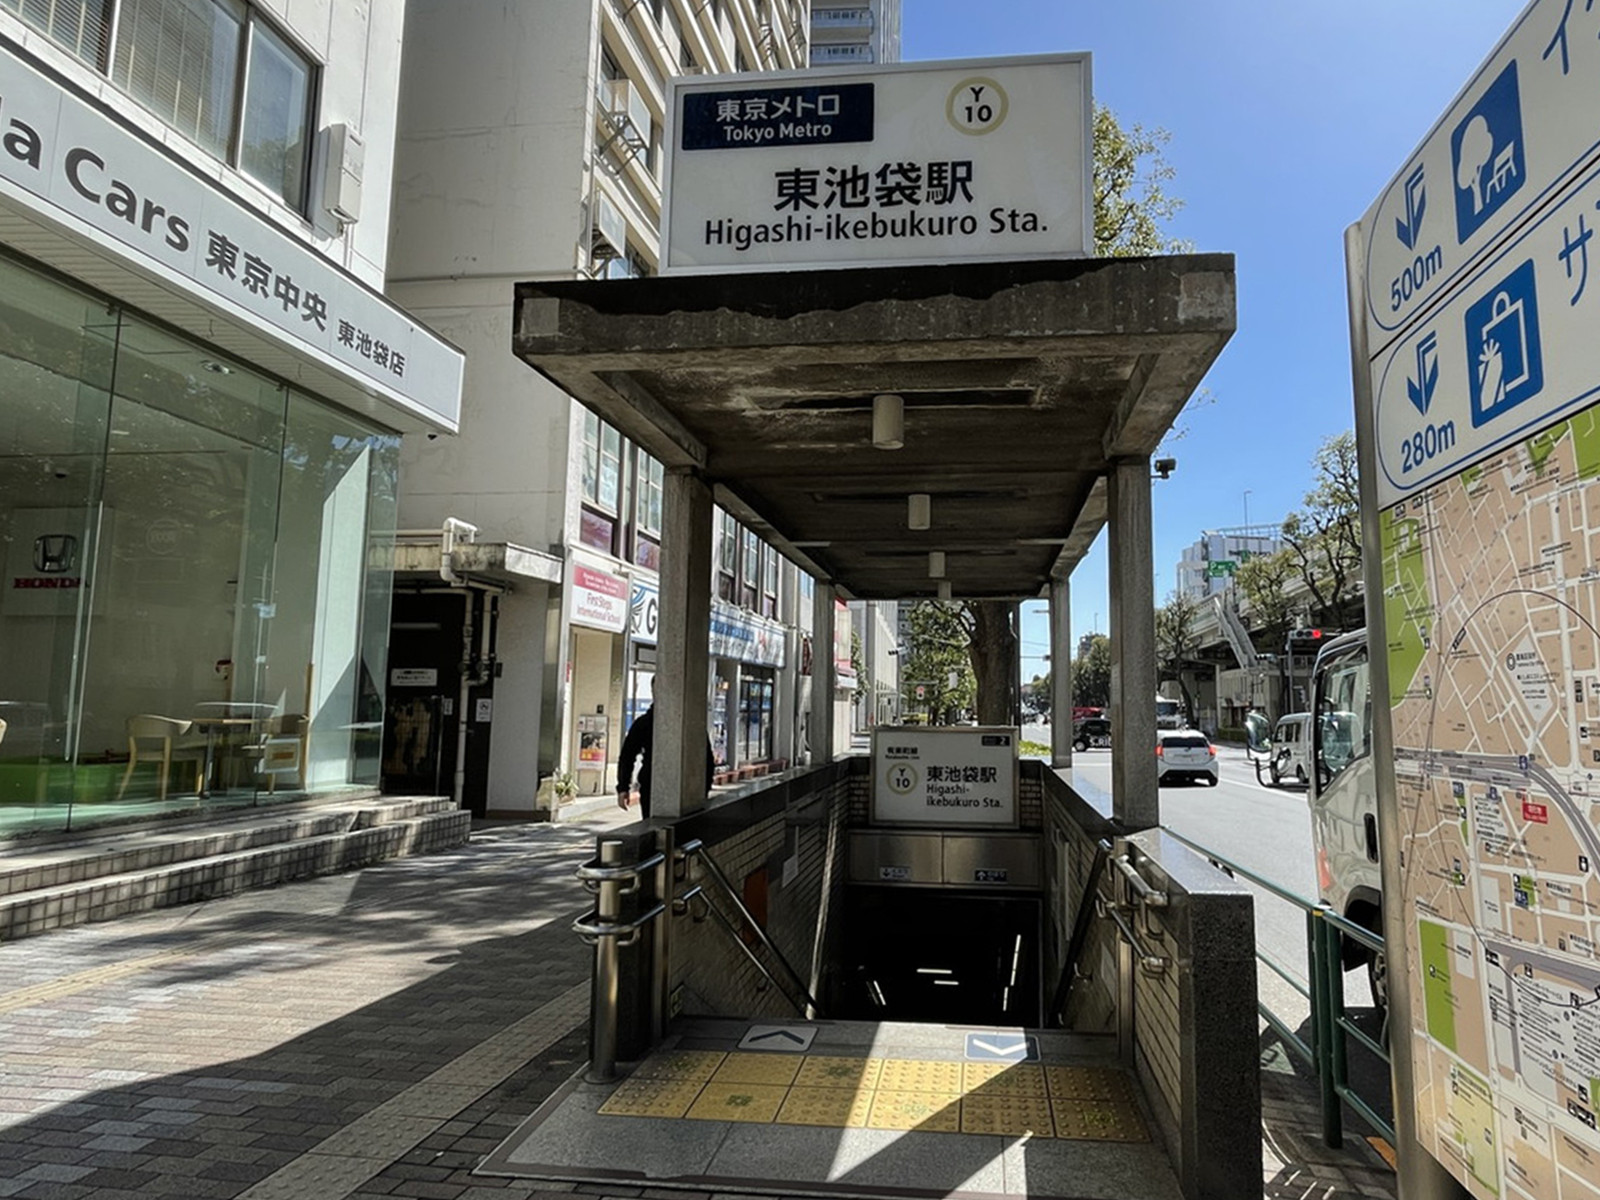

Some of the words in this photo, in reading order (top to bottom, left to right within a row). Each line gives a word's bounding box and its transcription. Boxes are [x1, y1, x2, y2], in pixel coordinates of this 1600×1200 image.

[716, 94, 840, 122] 東京メトロ
[969, 86, 985, 102] Y
[964, 105, 993, 124] 10
[723, 123, 775, 142] Tokyo
[779, 121, 832, 139] Metro
[64, 147, 190, 252] Cars
[773, 159, 975, 212] 東池袋駅
[704, 209, 978, 251] Higashi-ikebukuro
[989, 206, 1049, 234] Sta.
[1558, 203, 1598, 307] サ
[1391, 244, 1442, 312] 500m
[205, 228, 328, 332] 東京中央
[337, 317, 406, 378] 東池袋店
[1401, 419, 1456, 474] 280m
[895, 777, 911, 788] 10
[898, 767, 907, 777] Y
[926, 765, 998, 783] 東池袋駅
[926, 783, 970, 796] Higashi-
